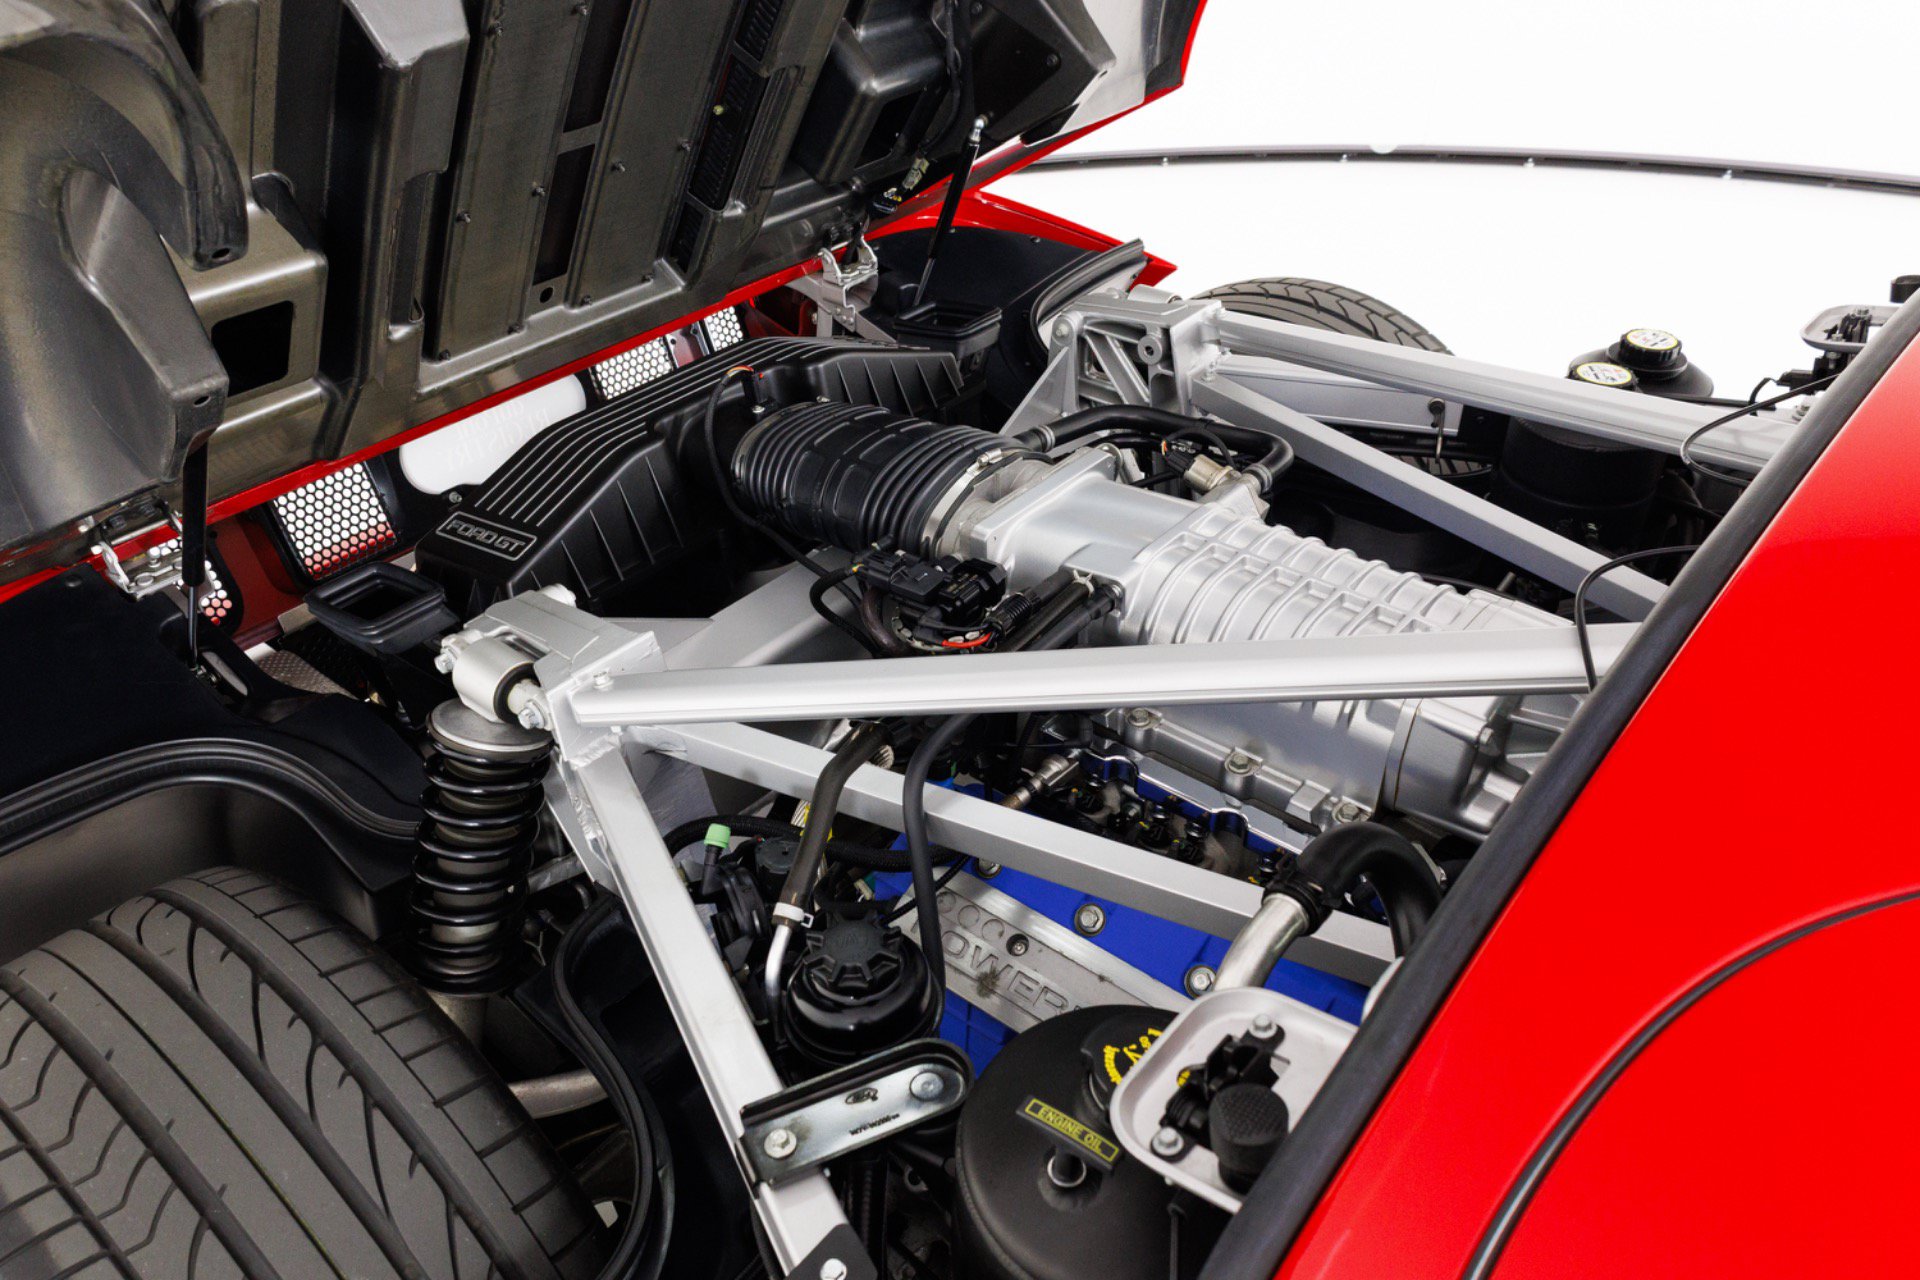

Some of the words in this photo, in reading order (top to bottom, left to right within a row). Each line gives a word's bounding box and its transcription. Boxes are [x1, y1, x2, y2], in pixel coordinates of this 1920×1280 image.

[446, 520, 498, 544] FORD
[494, 535, 526, 552] GT
[911, 918, 1081, 1017] OWER
[1037, 1106, 1083, 1140] ENGINE
[1083, 1133, 1103, 1153] OIL
